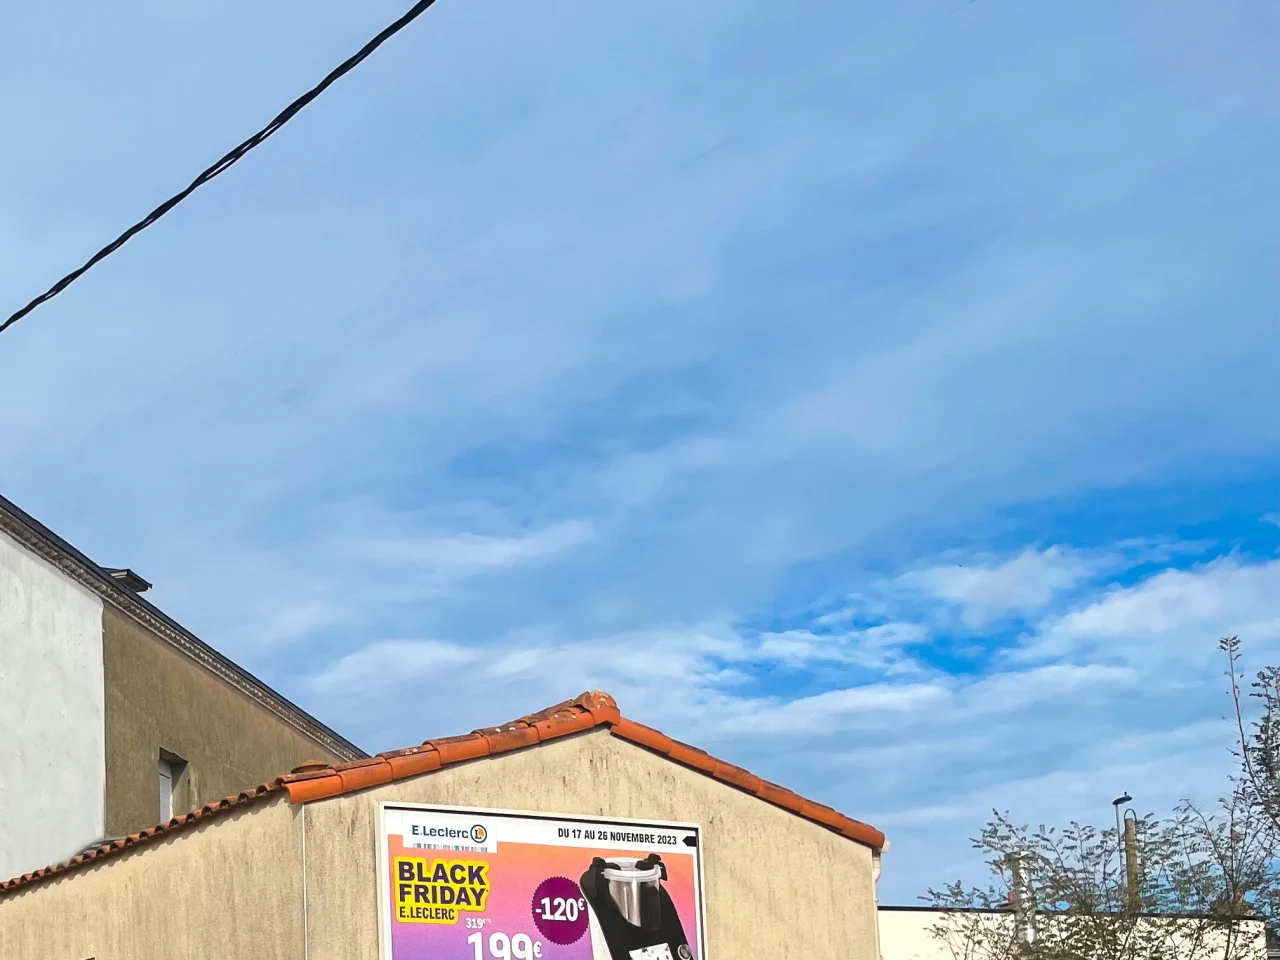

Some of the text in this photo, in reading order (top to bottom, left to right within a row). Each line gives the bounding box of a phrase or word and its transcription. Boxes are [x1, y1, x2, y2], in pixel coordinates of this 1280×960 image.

[412, 824, 469, 839] E.Leclerc
[558, 827, 677, 845] DU 17 AU 26 NOVEMBRE 2023
[398, 861, 486, 885] BLACK
[399, 906, 455, 920] E.LECLERC
